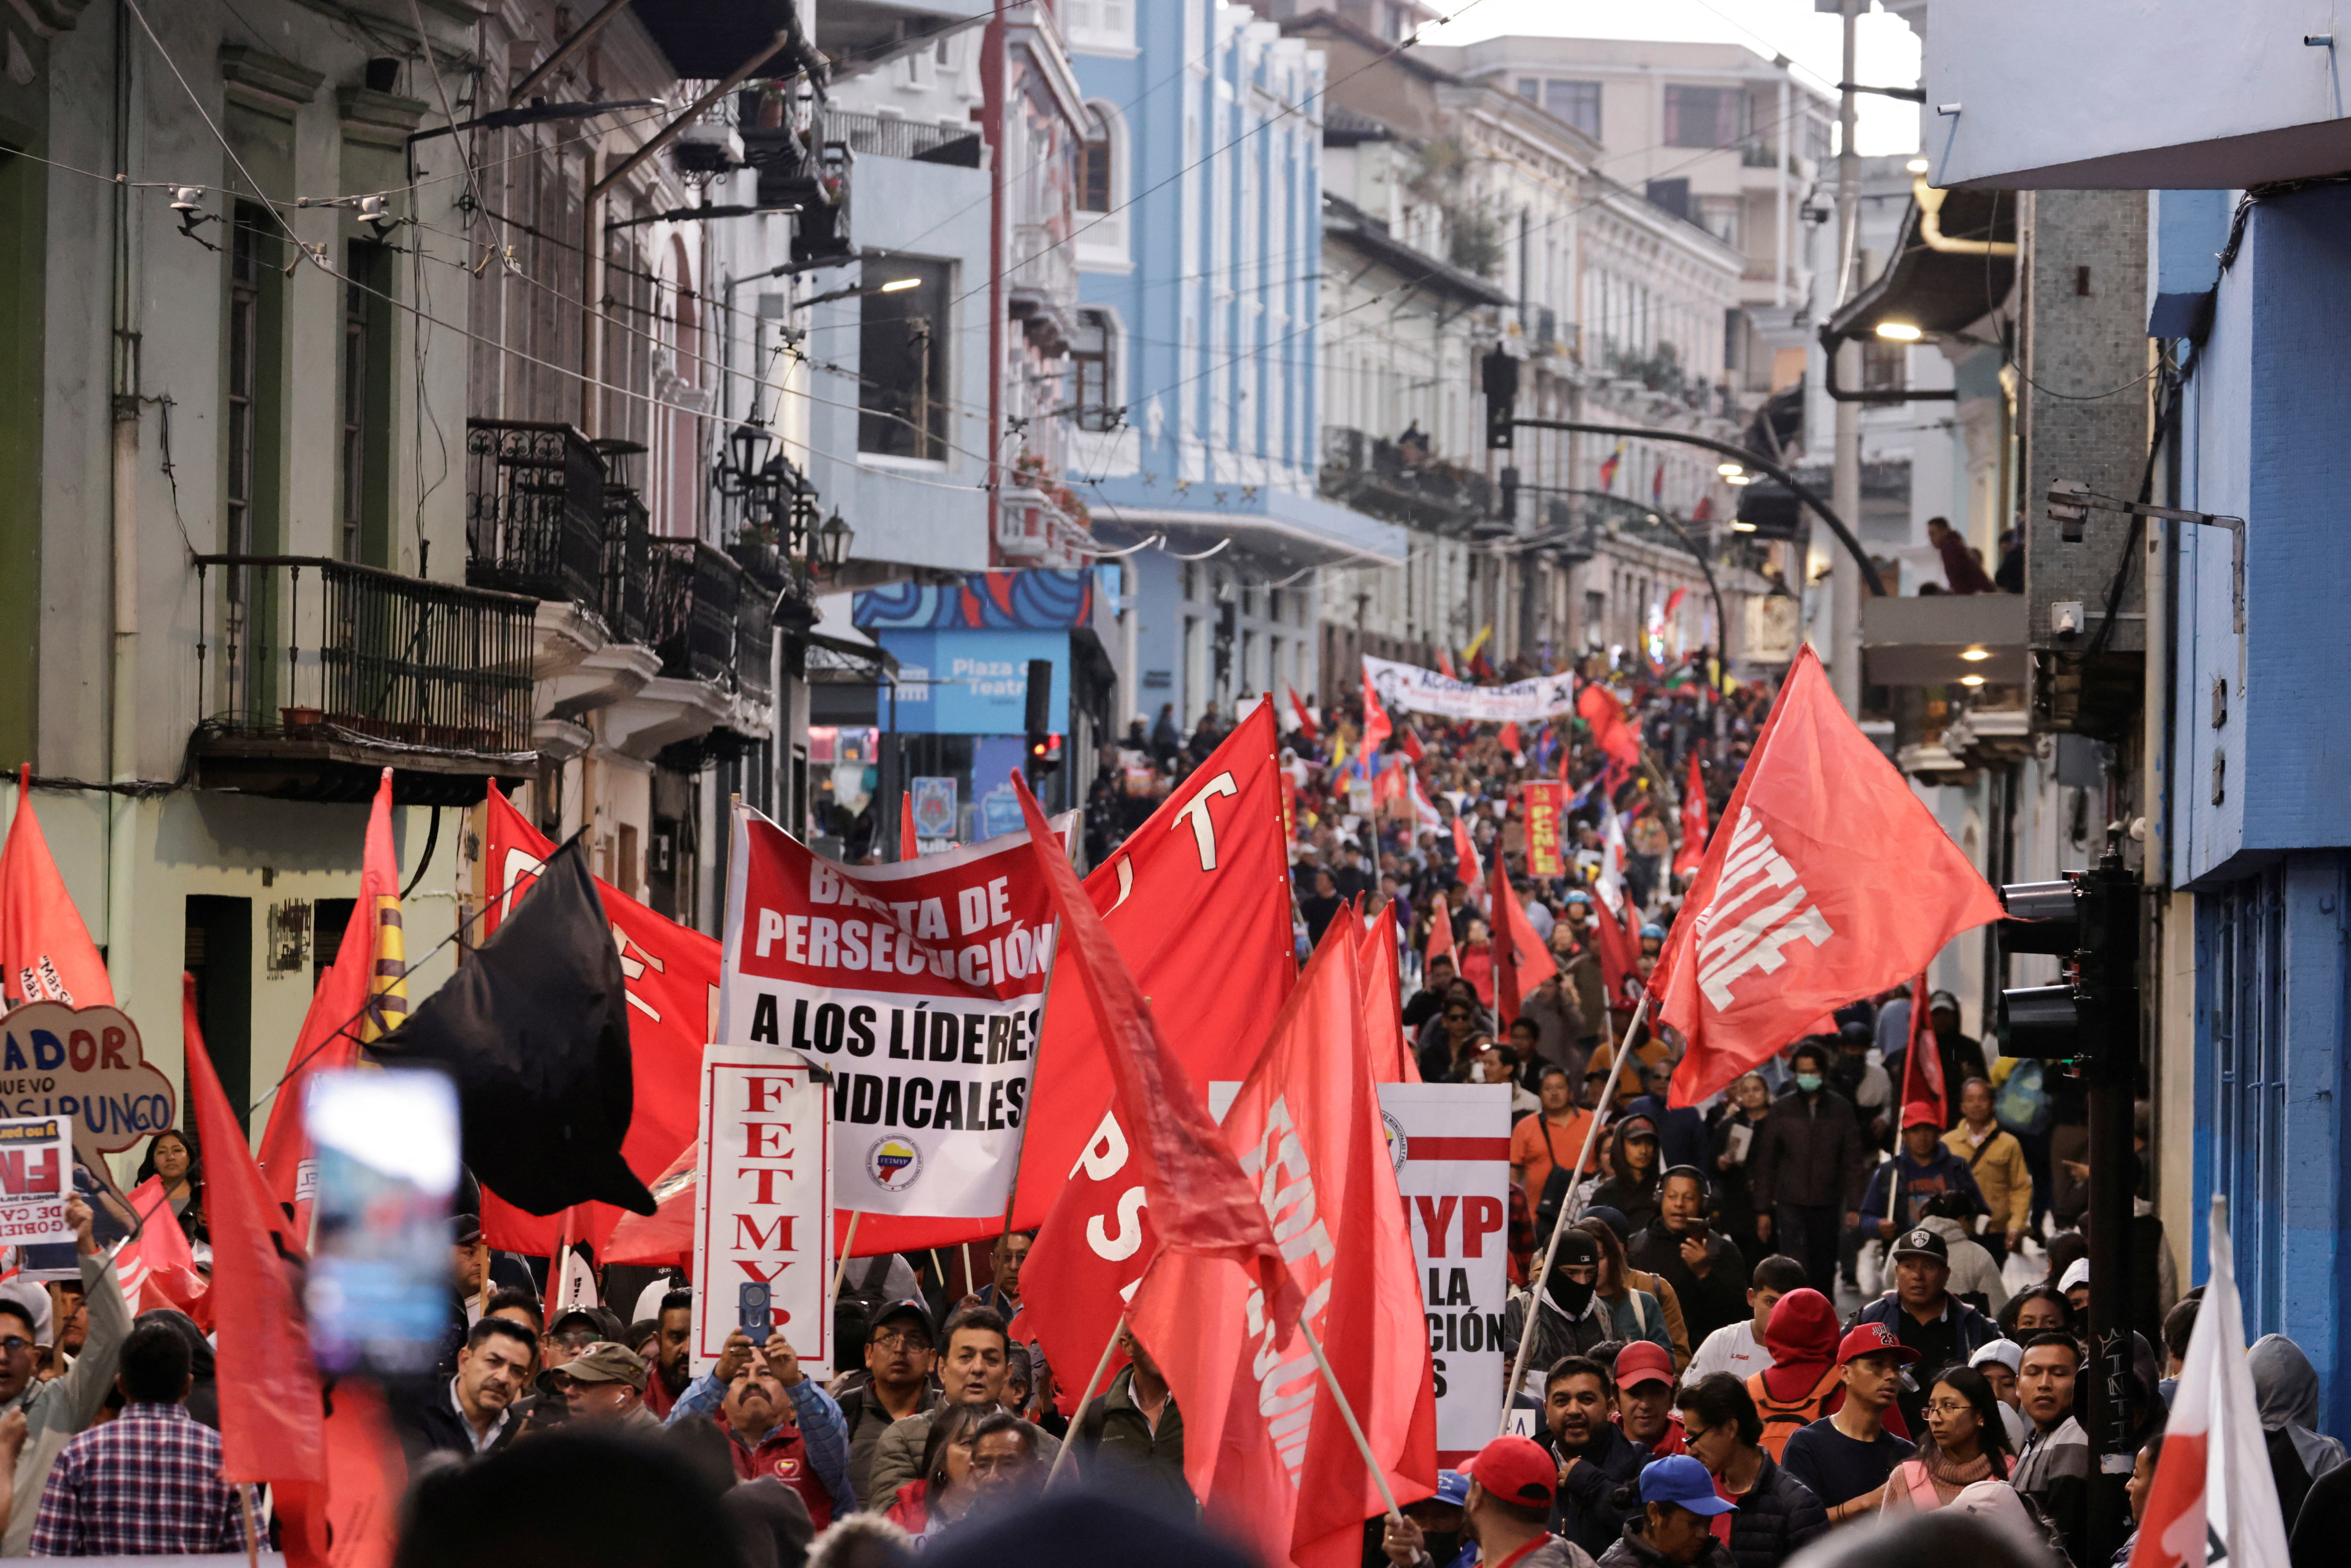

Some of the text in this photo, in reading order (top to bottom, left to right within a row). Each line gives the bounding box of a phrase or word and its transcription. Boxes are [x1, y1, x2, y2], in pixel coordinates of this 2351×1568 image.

[952, 658, 1013, 676] Plaza
[967, 678, 1026, 696] Teatr
[959, 876, 1011, 936] DE
[755, 908, 1052, 987] PERSECUCIÓN
[750, 993, 1040, 1064] A LOS LÍDERES
[828, 1070, 1027, 1131] NDICALES
[1388, 1117, 1406, 1150] MUNICIPALES
[1396, 1156, 1405, 1175] PROVI
[37, 1205, 62, 1219] DE
[0, 1220, 63, 1237] GOBIE
[1429, 1267, 1471, 1306] LA
[1879, 1333, 1895, 1347] 23
